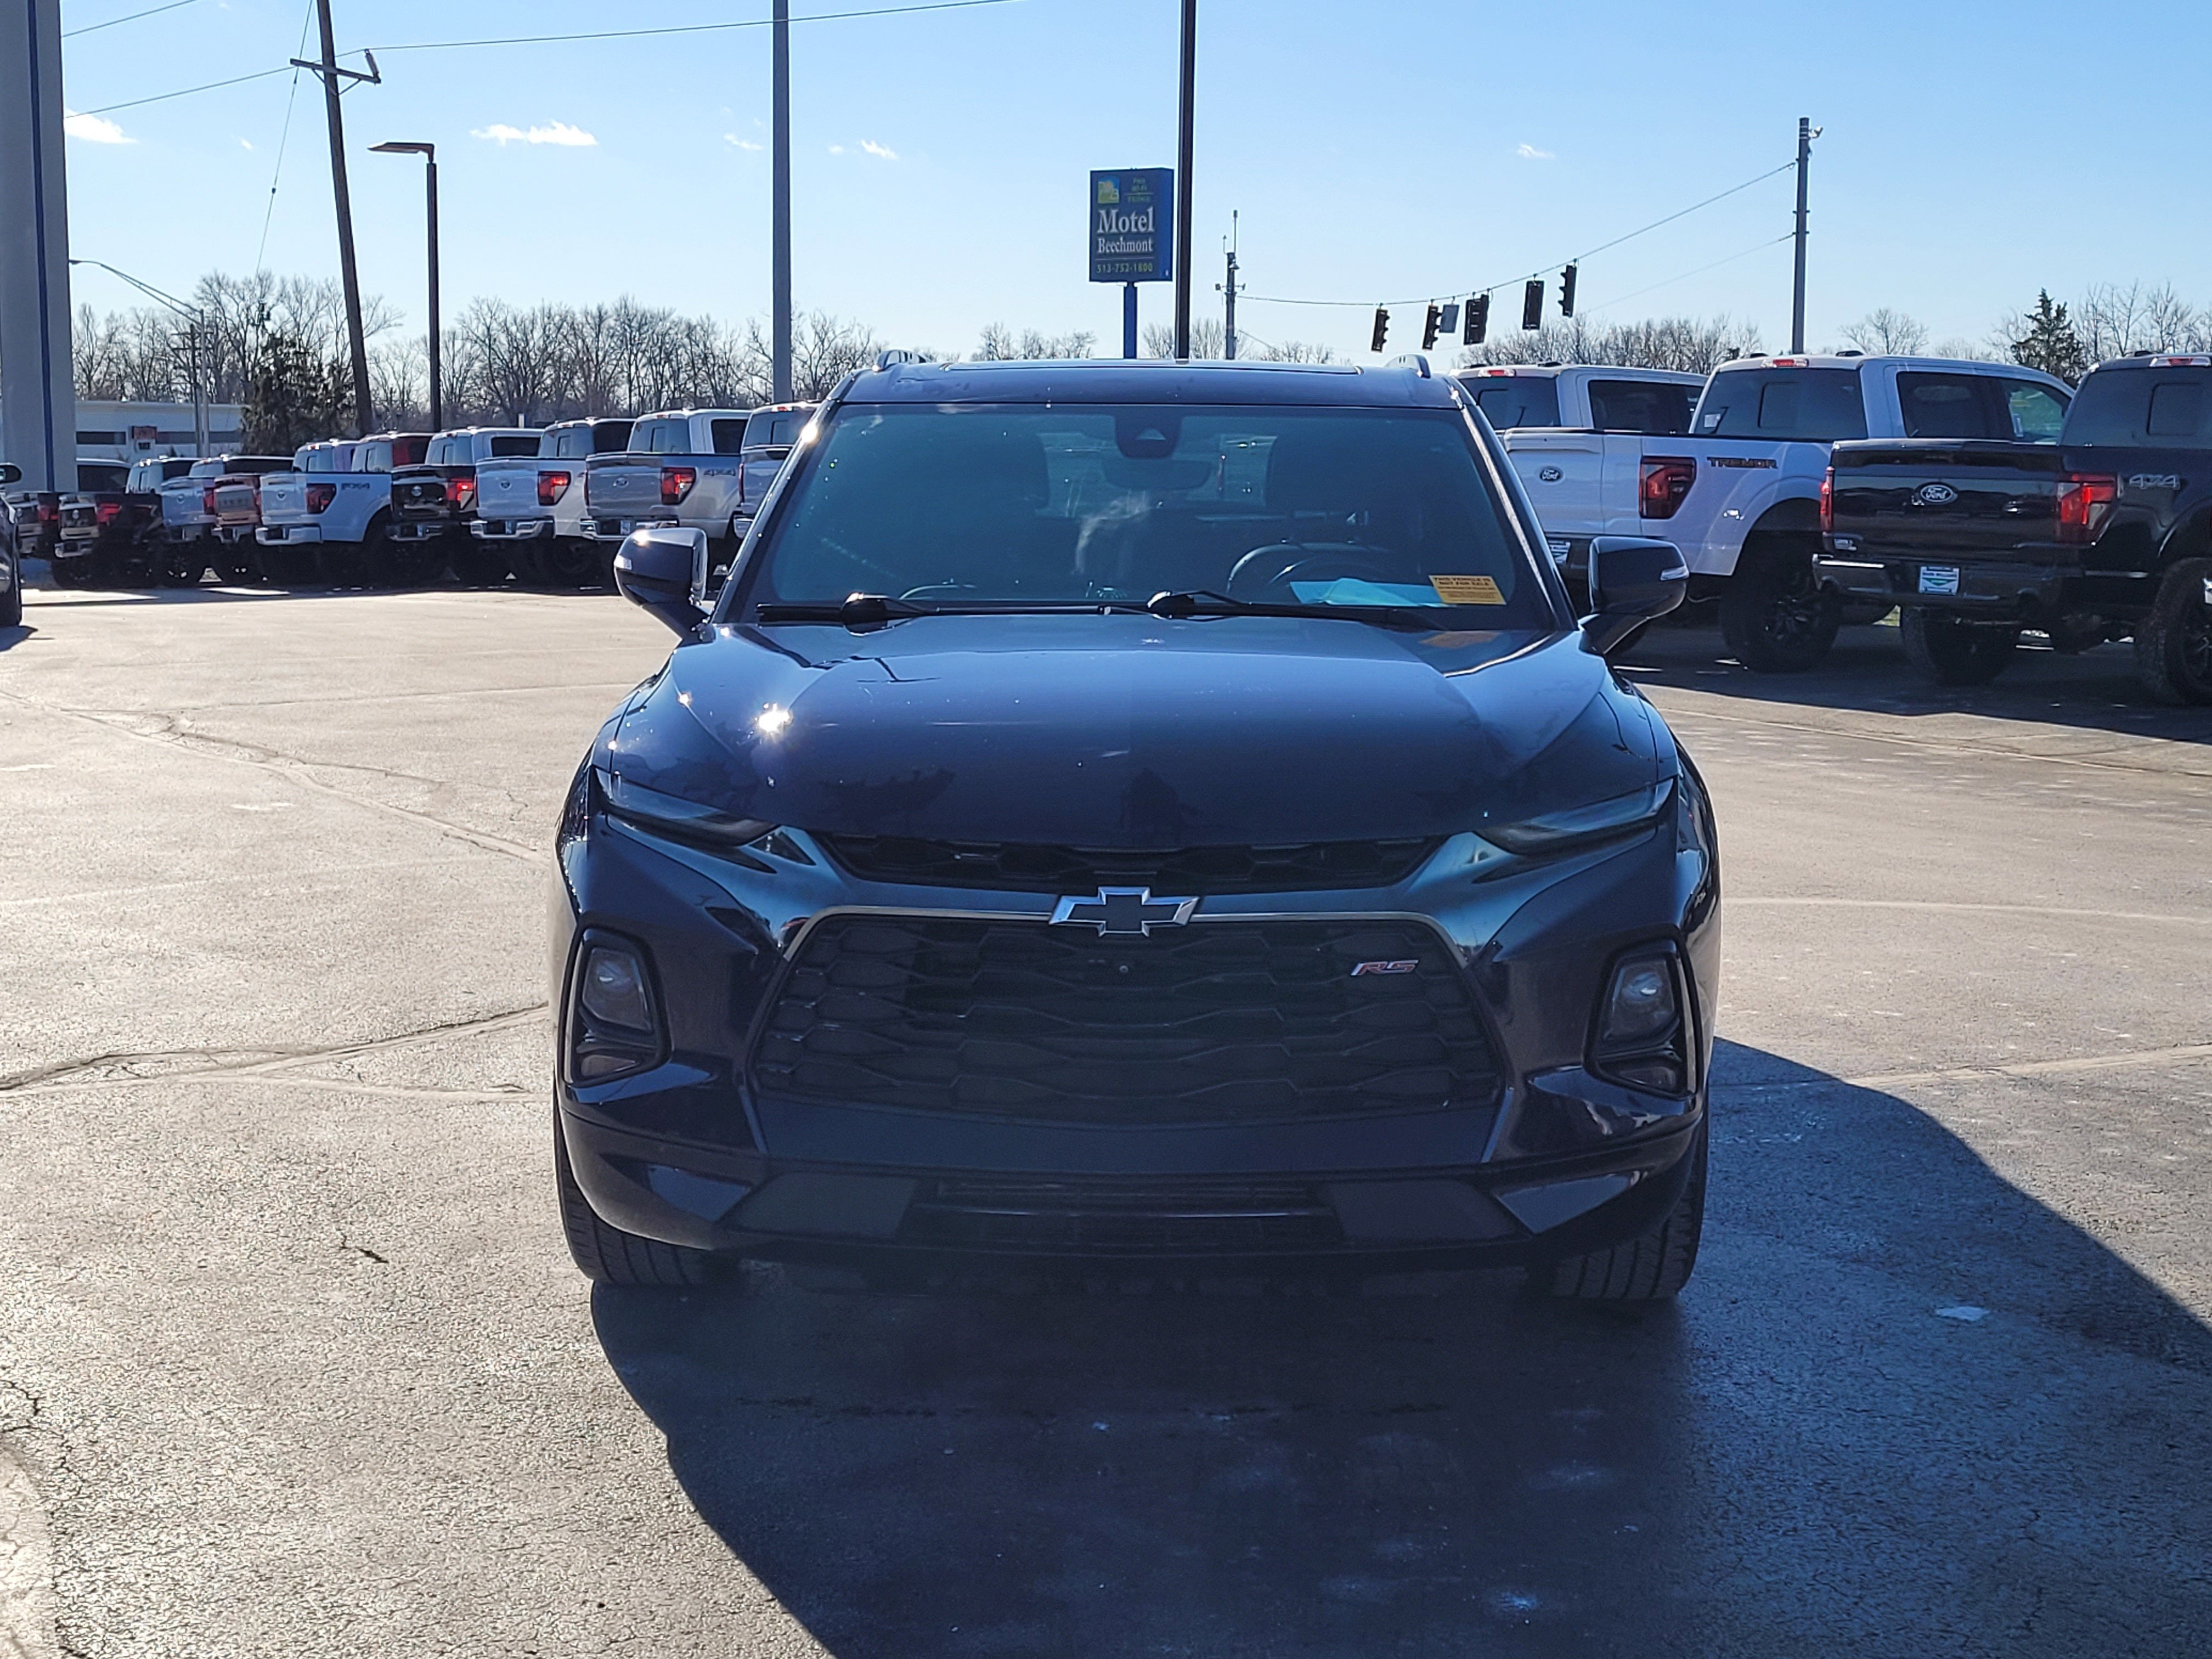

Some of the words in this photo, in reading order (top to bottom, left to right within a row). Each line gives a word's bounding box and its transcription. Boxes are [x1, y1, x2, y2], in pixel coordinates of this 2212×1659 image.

[1097, 206, 1155, 234] Motel
[1097, 236, 1153, 253] Beechmont
[1707, 456, 1778, 469] TREMOR
[1351, 960, 1419, 976] RS
